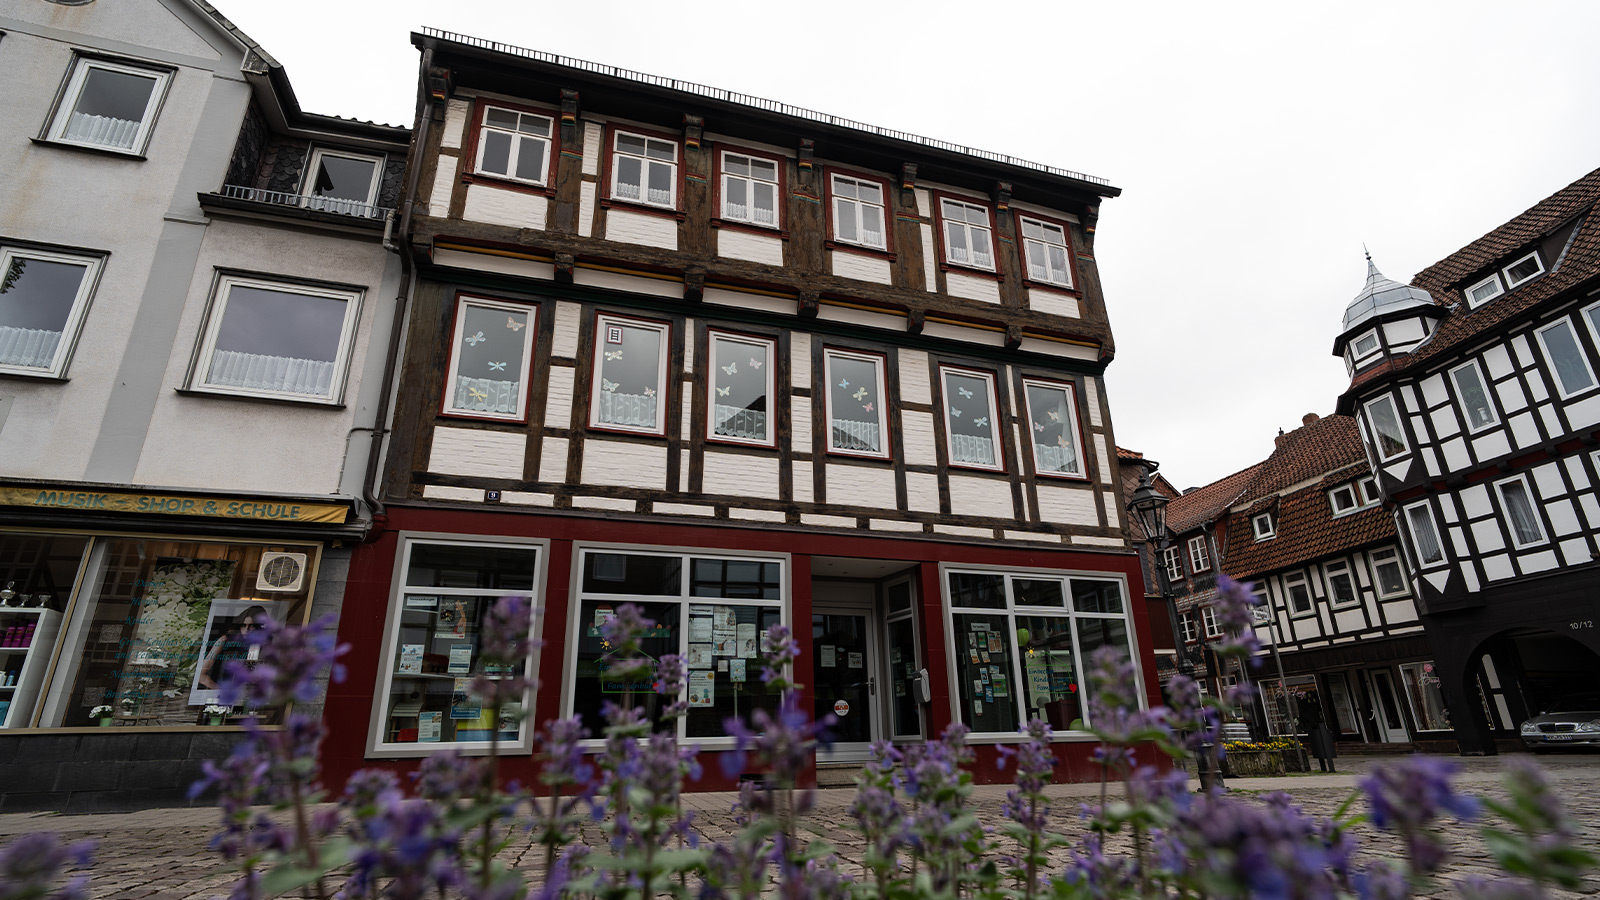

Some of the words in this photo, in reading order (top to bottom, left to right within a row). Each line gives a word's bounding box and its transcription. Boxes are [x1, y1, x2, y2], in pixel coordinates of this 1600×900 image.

[35, 490, 108, 509] MUSIK
[137, 496, 195, 514] SHOP
[203, 499, 218, 516] &
[227, 501, 301, 519] SCHULE
[1569, 620, 1594, 630] 10/12
